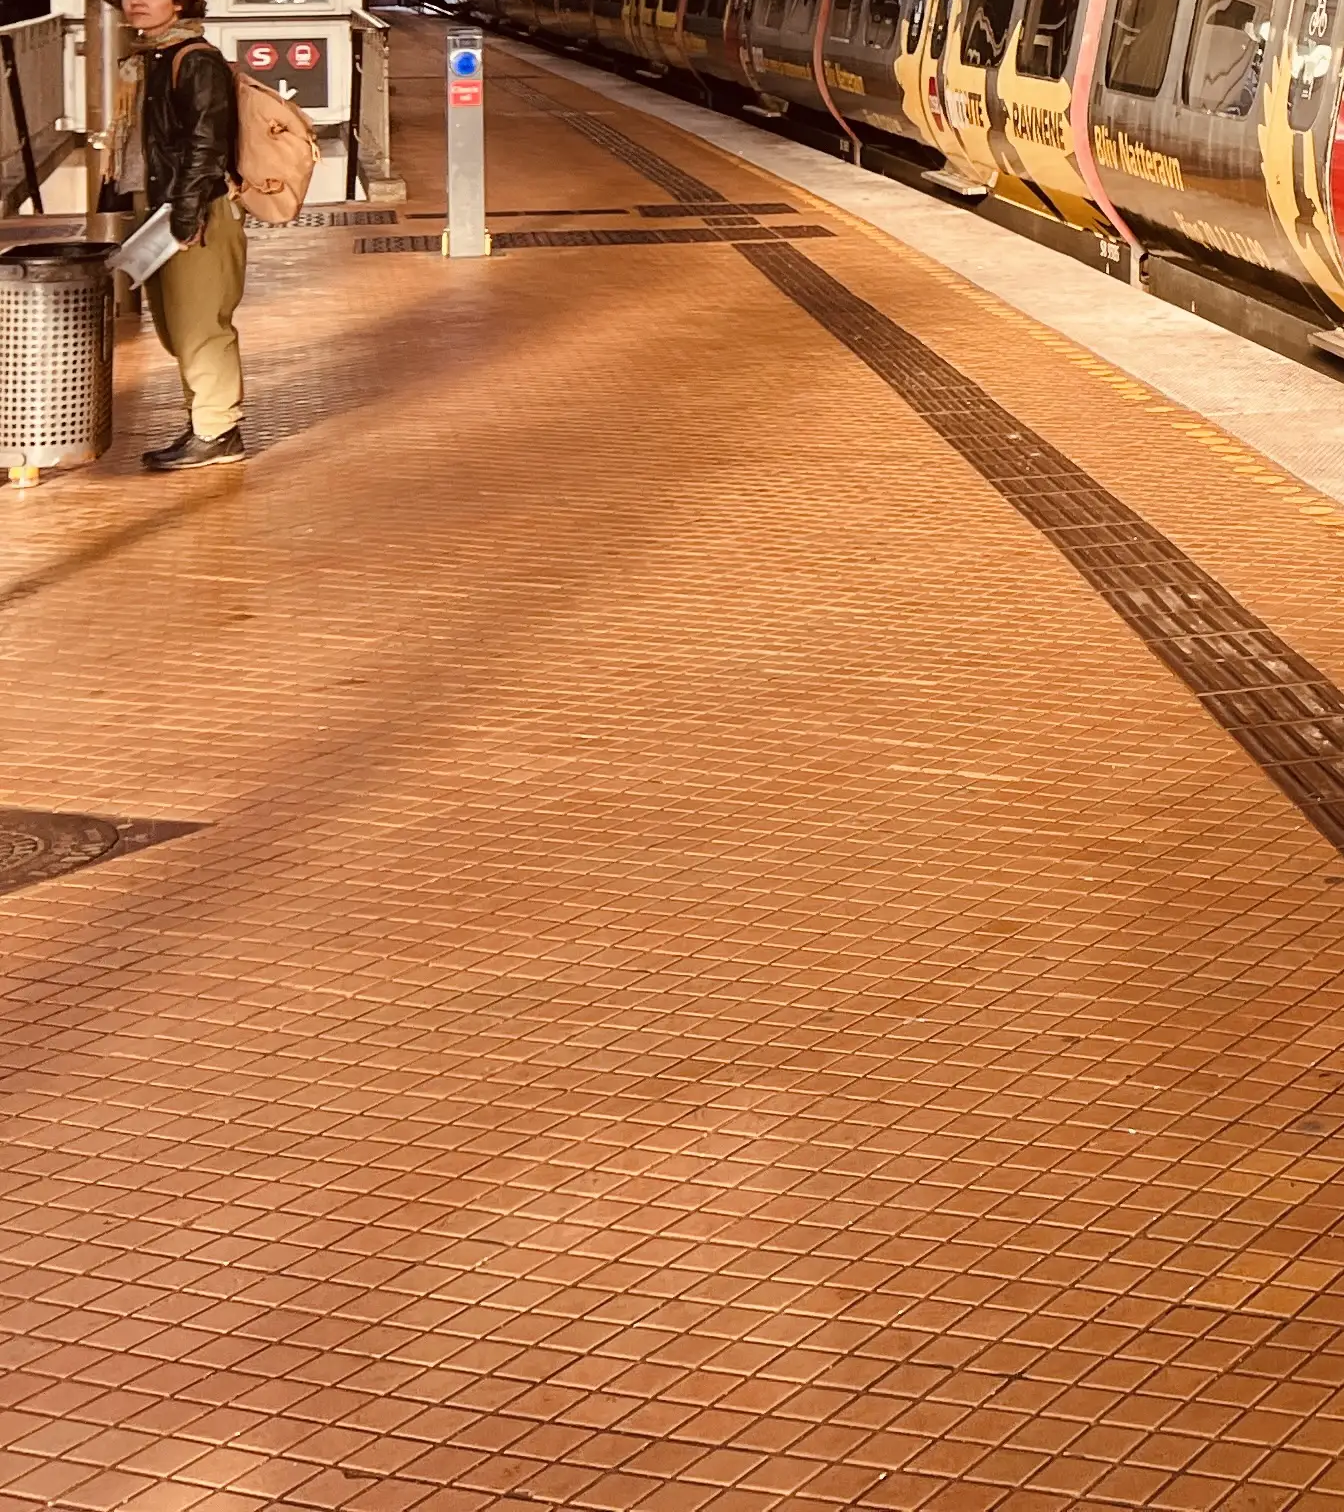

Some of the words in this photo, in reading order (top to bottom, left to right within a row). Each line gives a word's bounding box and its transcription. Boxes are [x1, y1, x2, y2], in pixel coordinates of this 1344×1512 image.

[252, 47, 271, 66] S
[1012, 102, 1065, 150] RAVNENE
[1094, 125, 1119, 170] Bliv
[1118, 131, 1185, 191] Natteravn
